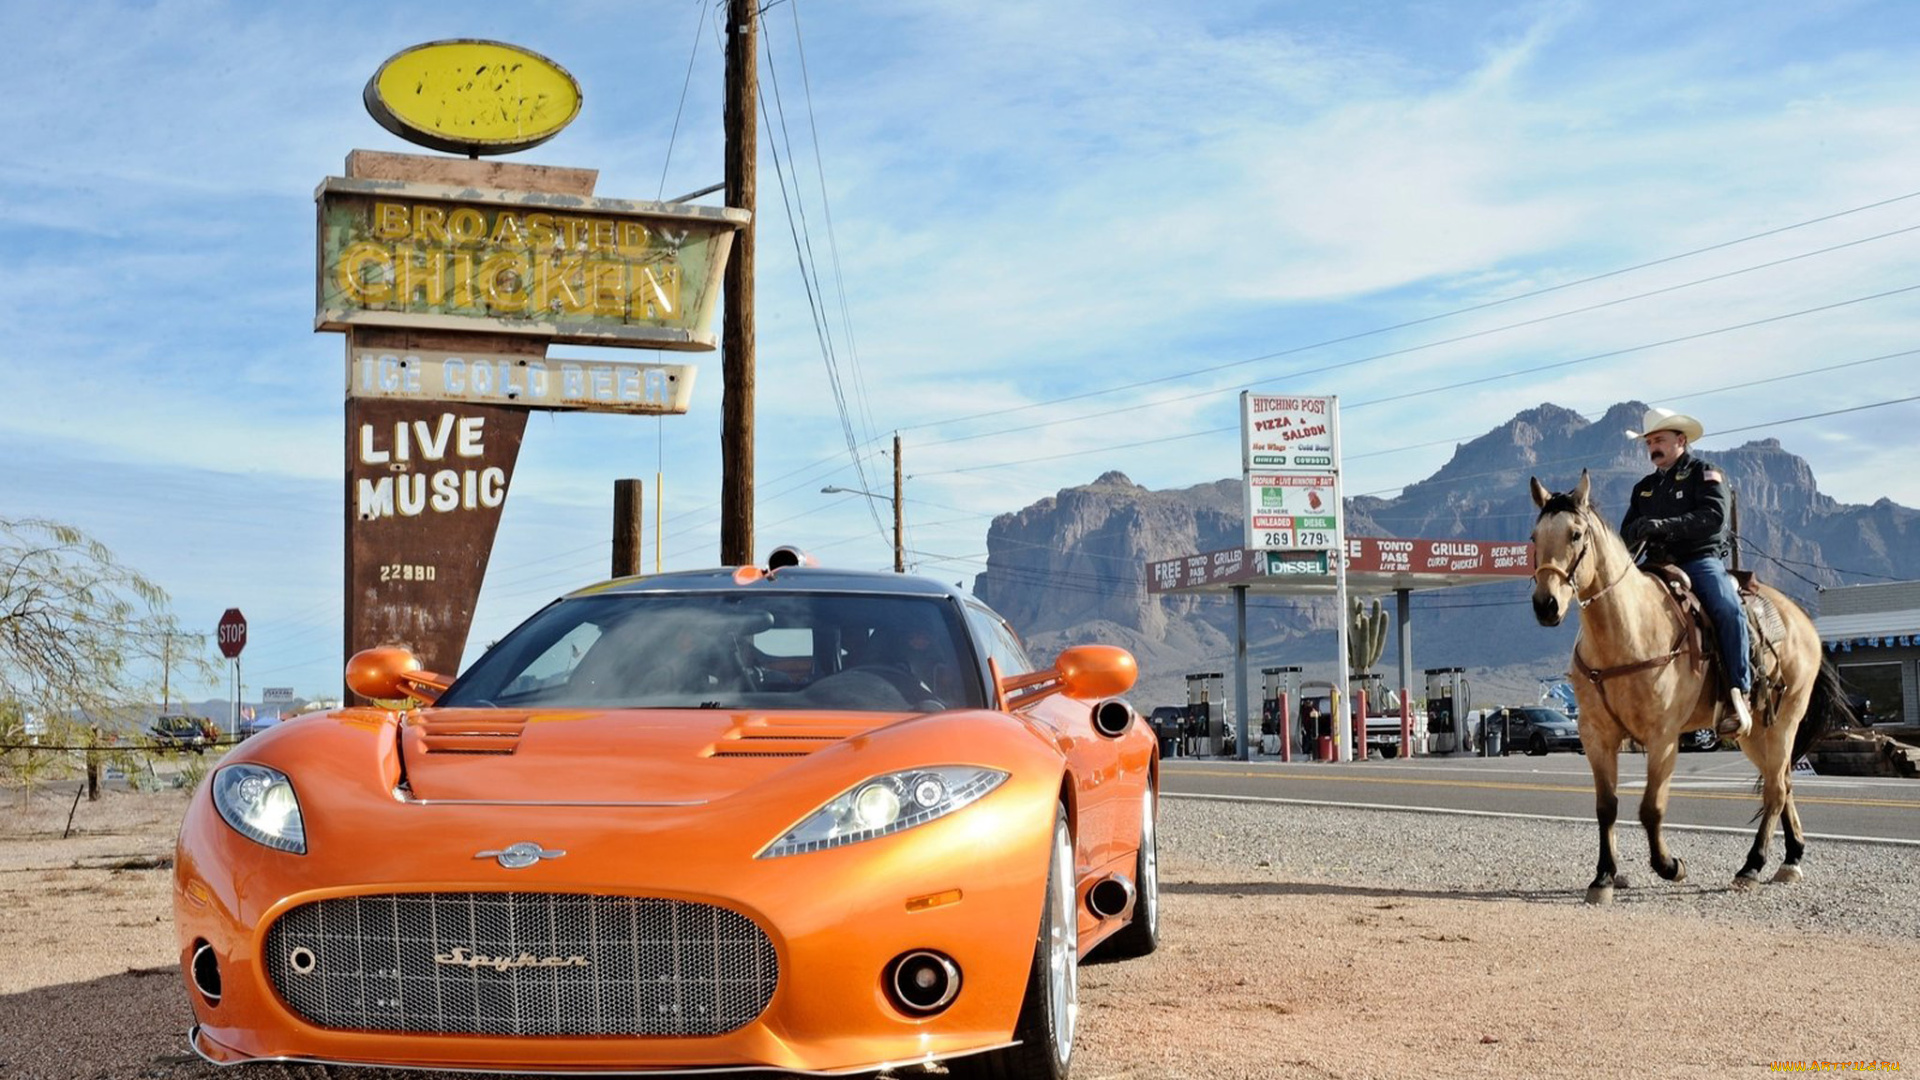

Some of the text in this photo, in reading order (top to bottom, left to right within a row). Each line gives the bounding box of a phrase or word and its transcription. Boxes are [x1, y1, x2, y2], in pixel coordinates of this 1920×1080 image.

[375, 202, 650, 257] BROASTED
[338, 241, 683, 320] CHICKEN
[360, 353, 668, 402] ICE COLD BEER
[1253, 398, 1326, 415] HITCHING POST
[1254, 417, 1292, 432] PIZZA
[359, 413, 486, 466] LIVE
[1282, 424, 1327, 442] SALOON
[1251, 476, 1276, 487] PROPANE
[1278, 477, 1292, 487] LIVE
[1320, 477, 1333, 487] BAIT
[357, 467, 506, 521] MUSIC
[1256, 517, 1291, 527] UNLEADED
[1303, 517, 1327, 528] DIESEL
[1265, 532, 1289, 546] 269
[1300, 532, 1323, 546] 279
[1376, 540, 1414, 552] TONTO
[1431, 542, 1479, 557] GRILLED
[1187, 556, 1208, 567] TONTO
[1213, 549, 1243, 566] GRILLED
[1381, 552, 1409, 563] PASS
[1427, 556, 1449, 568] CURRY
[1155, 560, 1182, 582] FREE
[1190, 567, 1205, 578] PASS
[1271, 561, 1325, 574] DIESEL
[1379, 563, 1396, 571] LIVE
[1160, 579, 1177, 589] INFO
[220, 623, 246, 644] STOP
[435, 947, 592, 972] Spyker
